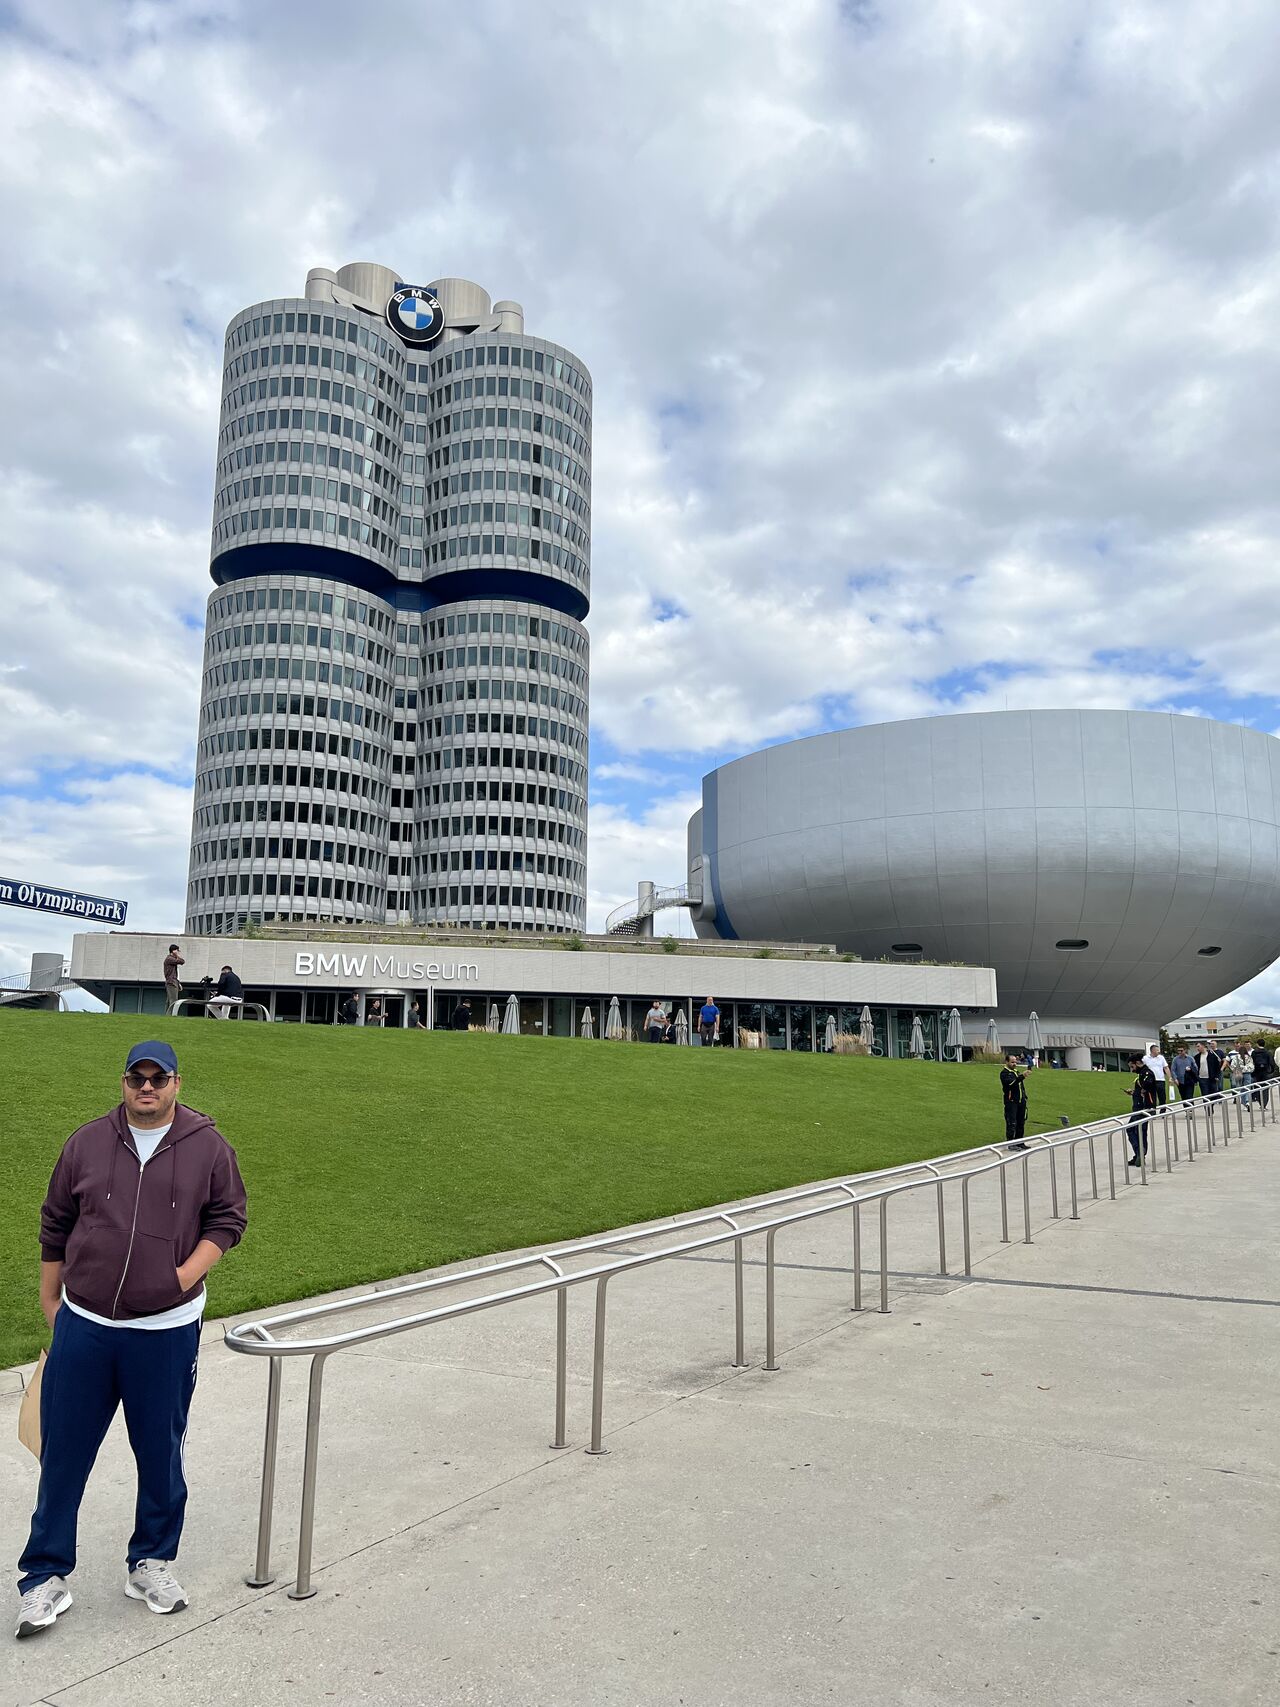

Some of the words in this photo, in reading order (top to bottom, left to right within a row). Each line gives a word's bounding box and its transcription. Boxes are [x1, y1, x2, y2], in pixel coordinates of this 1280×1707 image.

[394, 290, 439, 309] BMW
[0, 884, 12, 900] m
[18, 884, 122, 919] Olympiapark
[295, 952, 368, 977] BMW
[373, 955, 480, 981] Museum
[1047, 1034, 1116, 1048] museum
